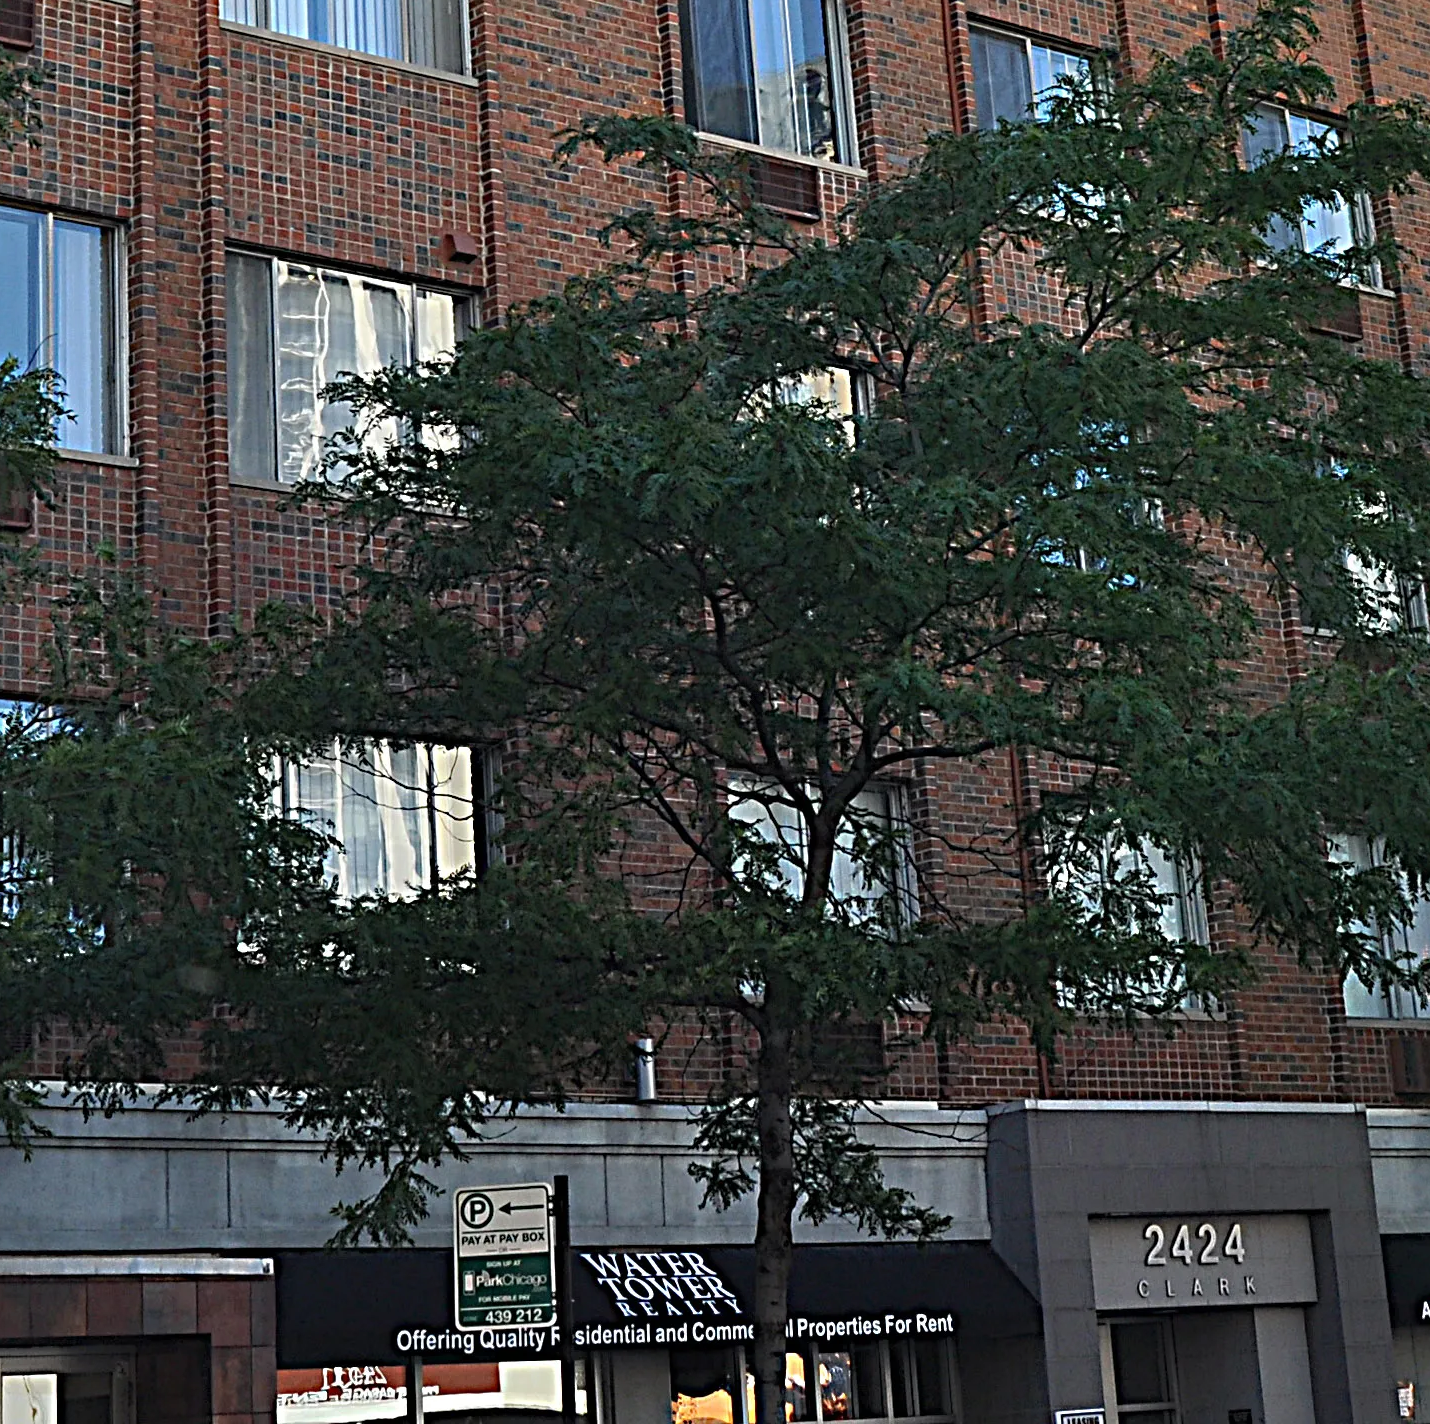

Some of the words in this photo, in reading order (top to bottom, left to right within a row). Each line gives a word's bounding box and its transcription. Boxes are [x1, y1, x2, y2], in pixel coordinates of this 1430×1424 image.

[461, 1235, 481, 1245] PAY
[483, 1234, 496, 1244] AT
[499, 1233, 519, 1243] PAY
[522, 1231, 545, 1242] BOX
[1145, 1224, 1245, 1265] 2424
[580, 1252, 717, 1277] WATER
[476, 1273, 547, 1287] ParkChicago
[598, 1276, 736, 1301] TOWER
[1138, 1277, 1256, 1298] CLARK
[485, 1310, 512, 1324] 439
[516, 1308, 542, 1322] 212
[615, 1299, 743, 1317] REALTY
[397, 1329, 474, 1353] Offering
[480, 1327, 545, 1351] Quality
[551, 1324, 651, 1347] Rsidential
[656, 1323, 687, 1343] and
[692, 1320, 793, 1342] Commel
[798, 1316, 881, 1340] Properties
[885, 1315, 912, 1334] For
[917, 1313, 953, 1333] Rent
